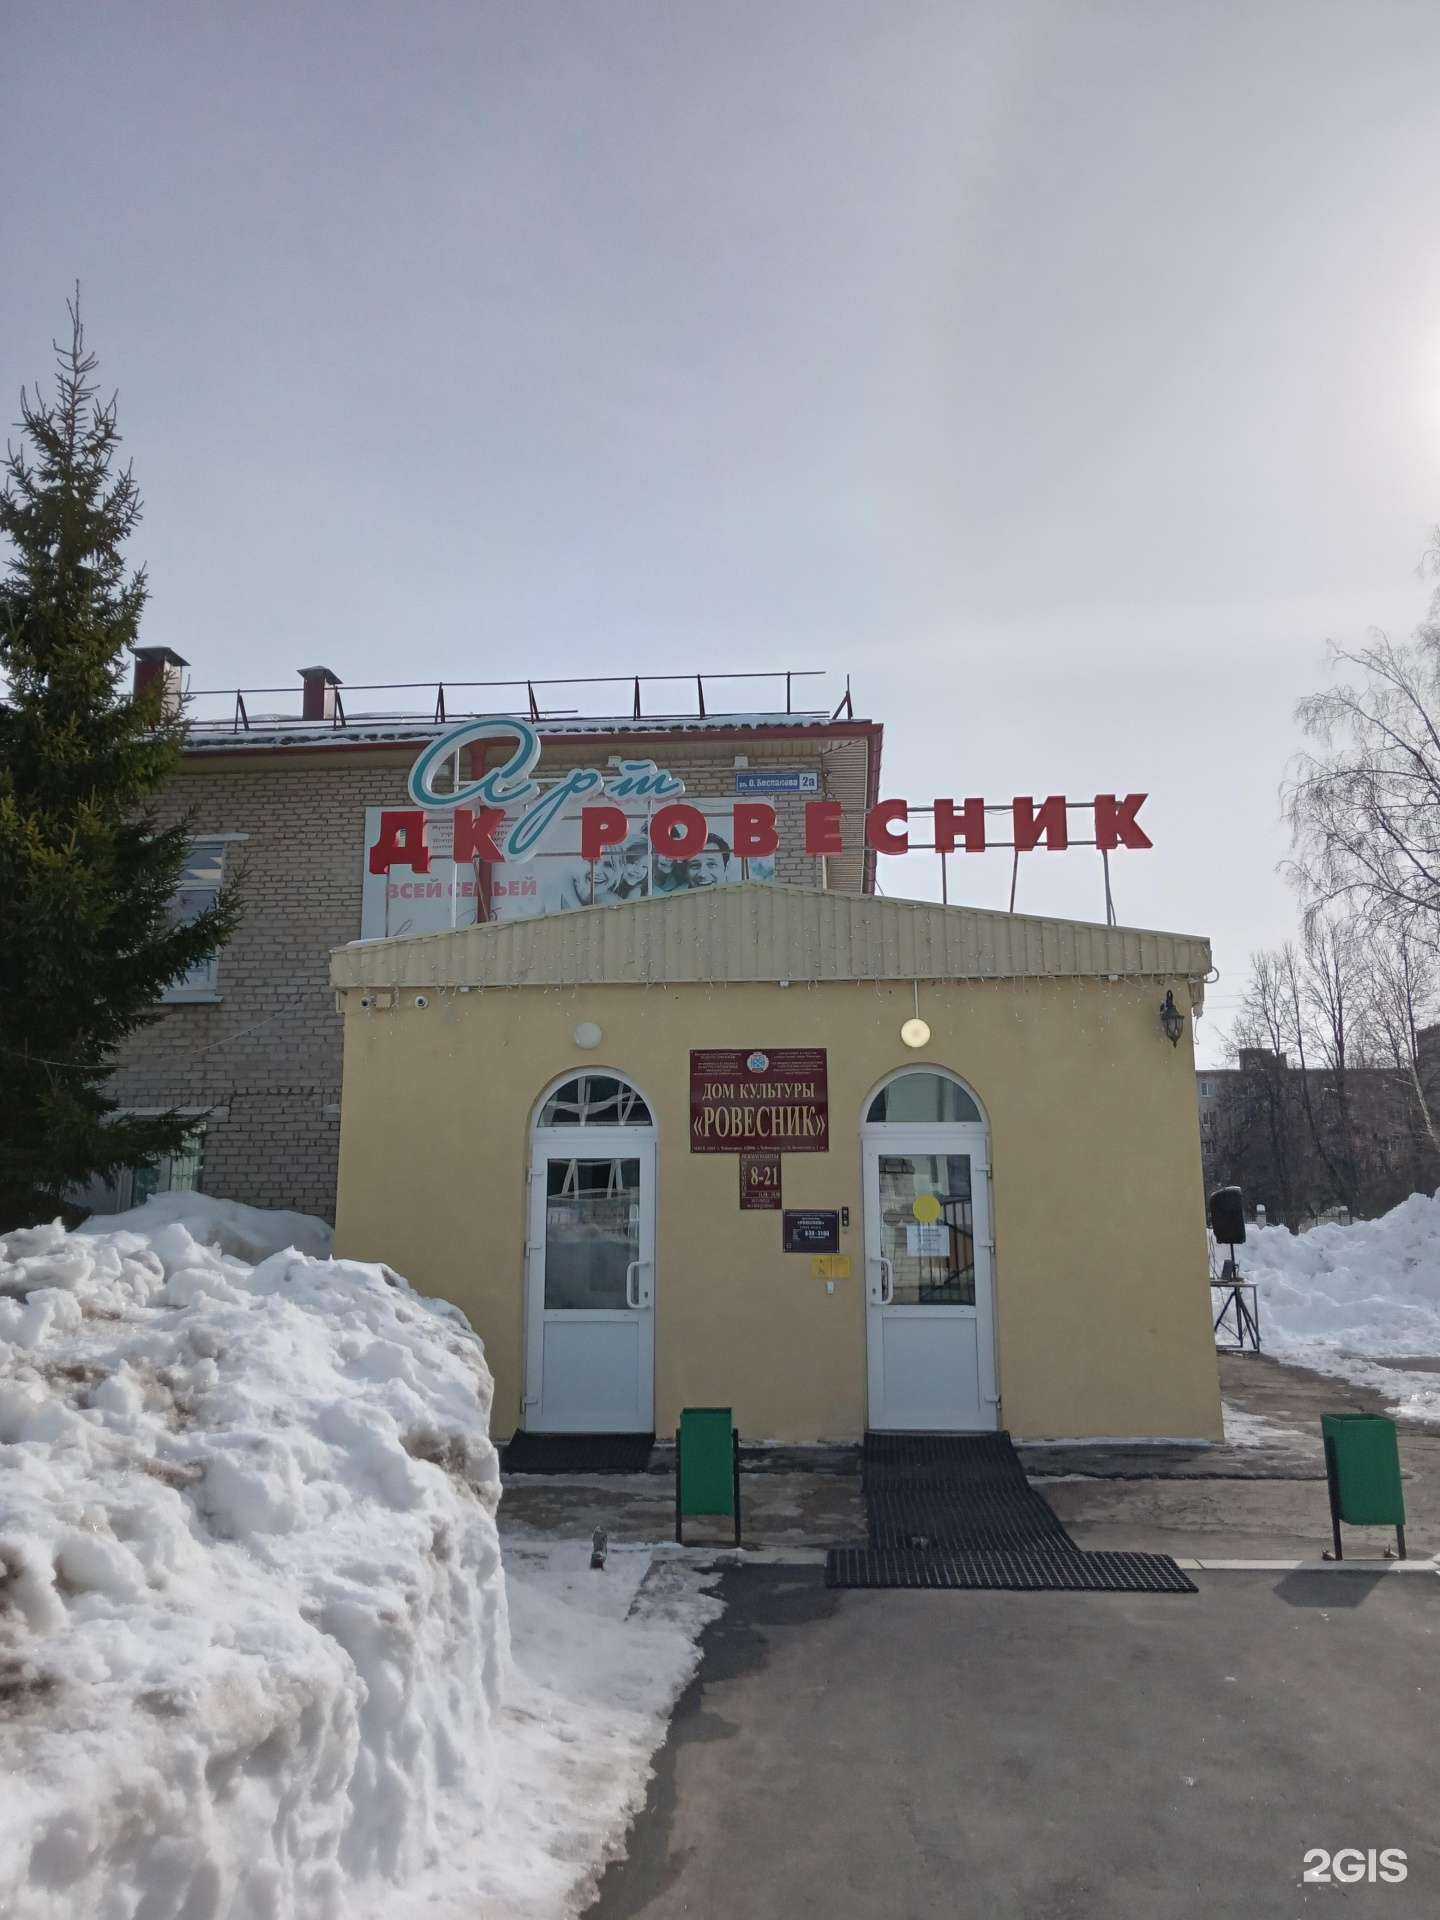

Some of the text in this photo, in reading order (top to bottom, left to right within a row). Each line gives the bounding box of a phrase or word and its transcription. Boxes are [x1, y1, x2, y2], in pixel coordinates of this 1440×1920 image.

[408, 716, 685, 863] Арт
[369, 793, 1154, 874] ДК РОВЕСНИК
[387, 876, 537, 899] ВСЕЙ СЕЬЕЙ
[702, 1082, 815, 1101] ДОМ КУЛЬТУРЫ
[693, 1105, 826, 1137] «РОВЕСНИК»
